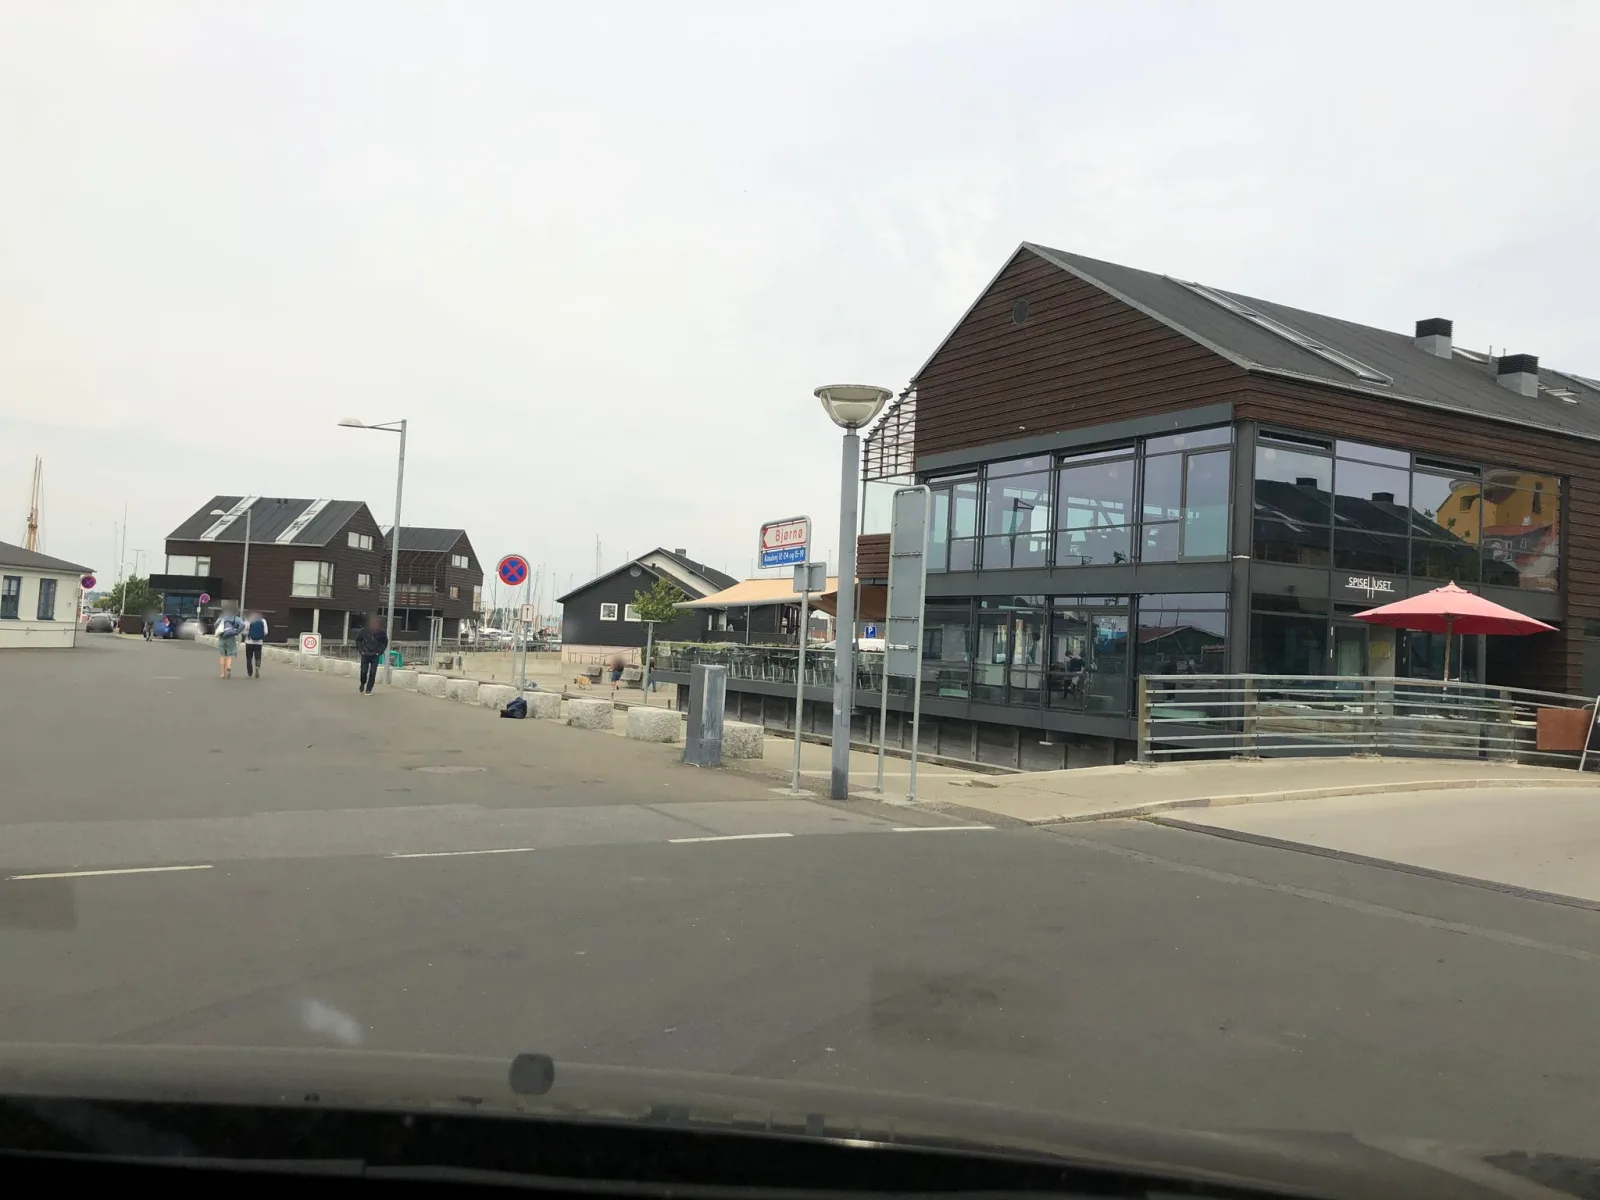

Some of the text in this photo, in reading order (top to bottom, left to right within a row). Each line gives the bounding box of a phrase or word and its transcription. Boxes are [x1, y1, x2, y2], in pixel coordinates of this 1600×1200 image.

[775, 528, 803, 543] Bjørnø
[789, 553, 794, 561] og
[1347, 576, 1393, 598] SPISEHUSET
